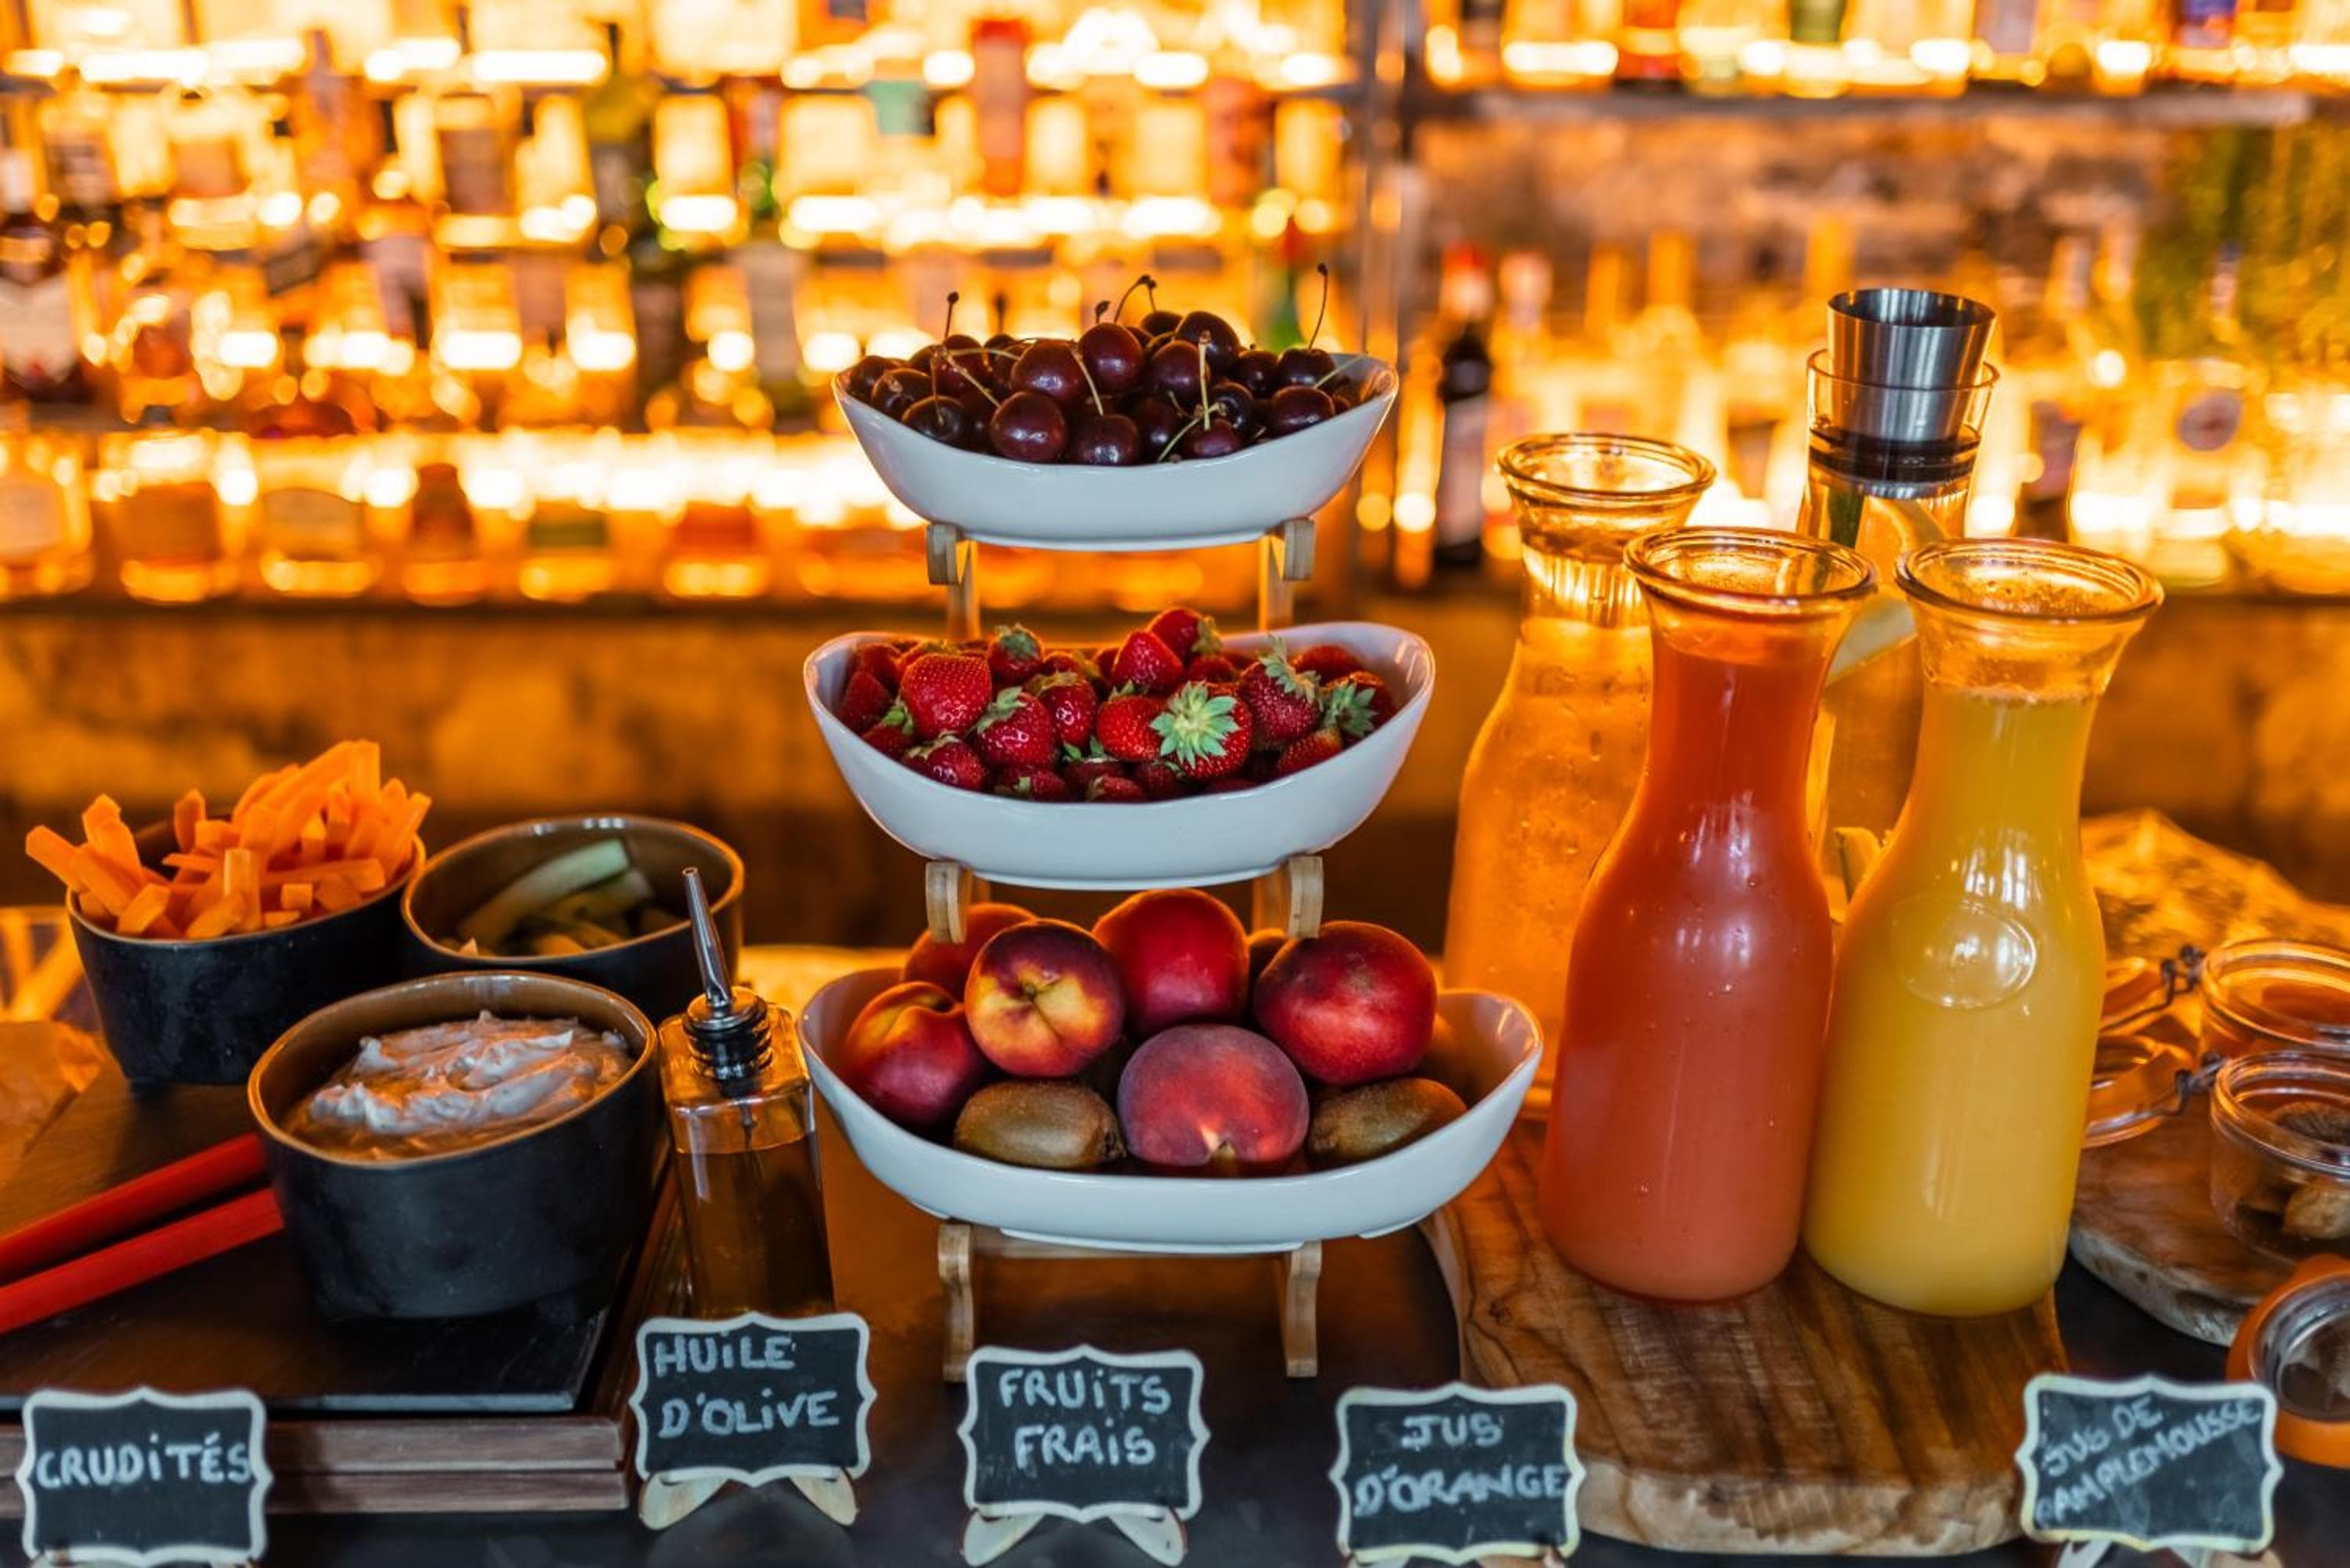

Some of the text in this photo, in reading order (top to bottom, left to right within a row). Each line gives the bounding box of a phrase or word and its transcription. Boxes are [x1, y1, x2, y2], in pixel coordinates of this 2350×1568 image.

[1401, 1413, 1502, 1448] JUS
[2037, 1399, 2261, 1523] PAMPLEMOUSSE
[2043, 1396, 2163, 1476] JUS DE
[1354, 1464, 1567, 1517] D'ORANGE
